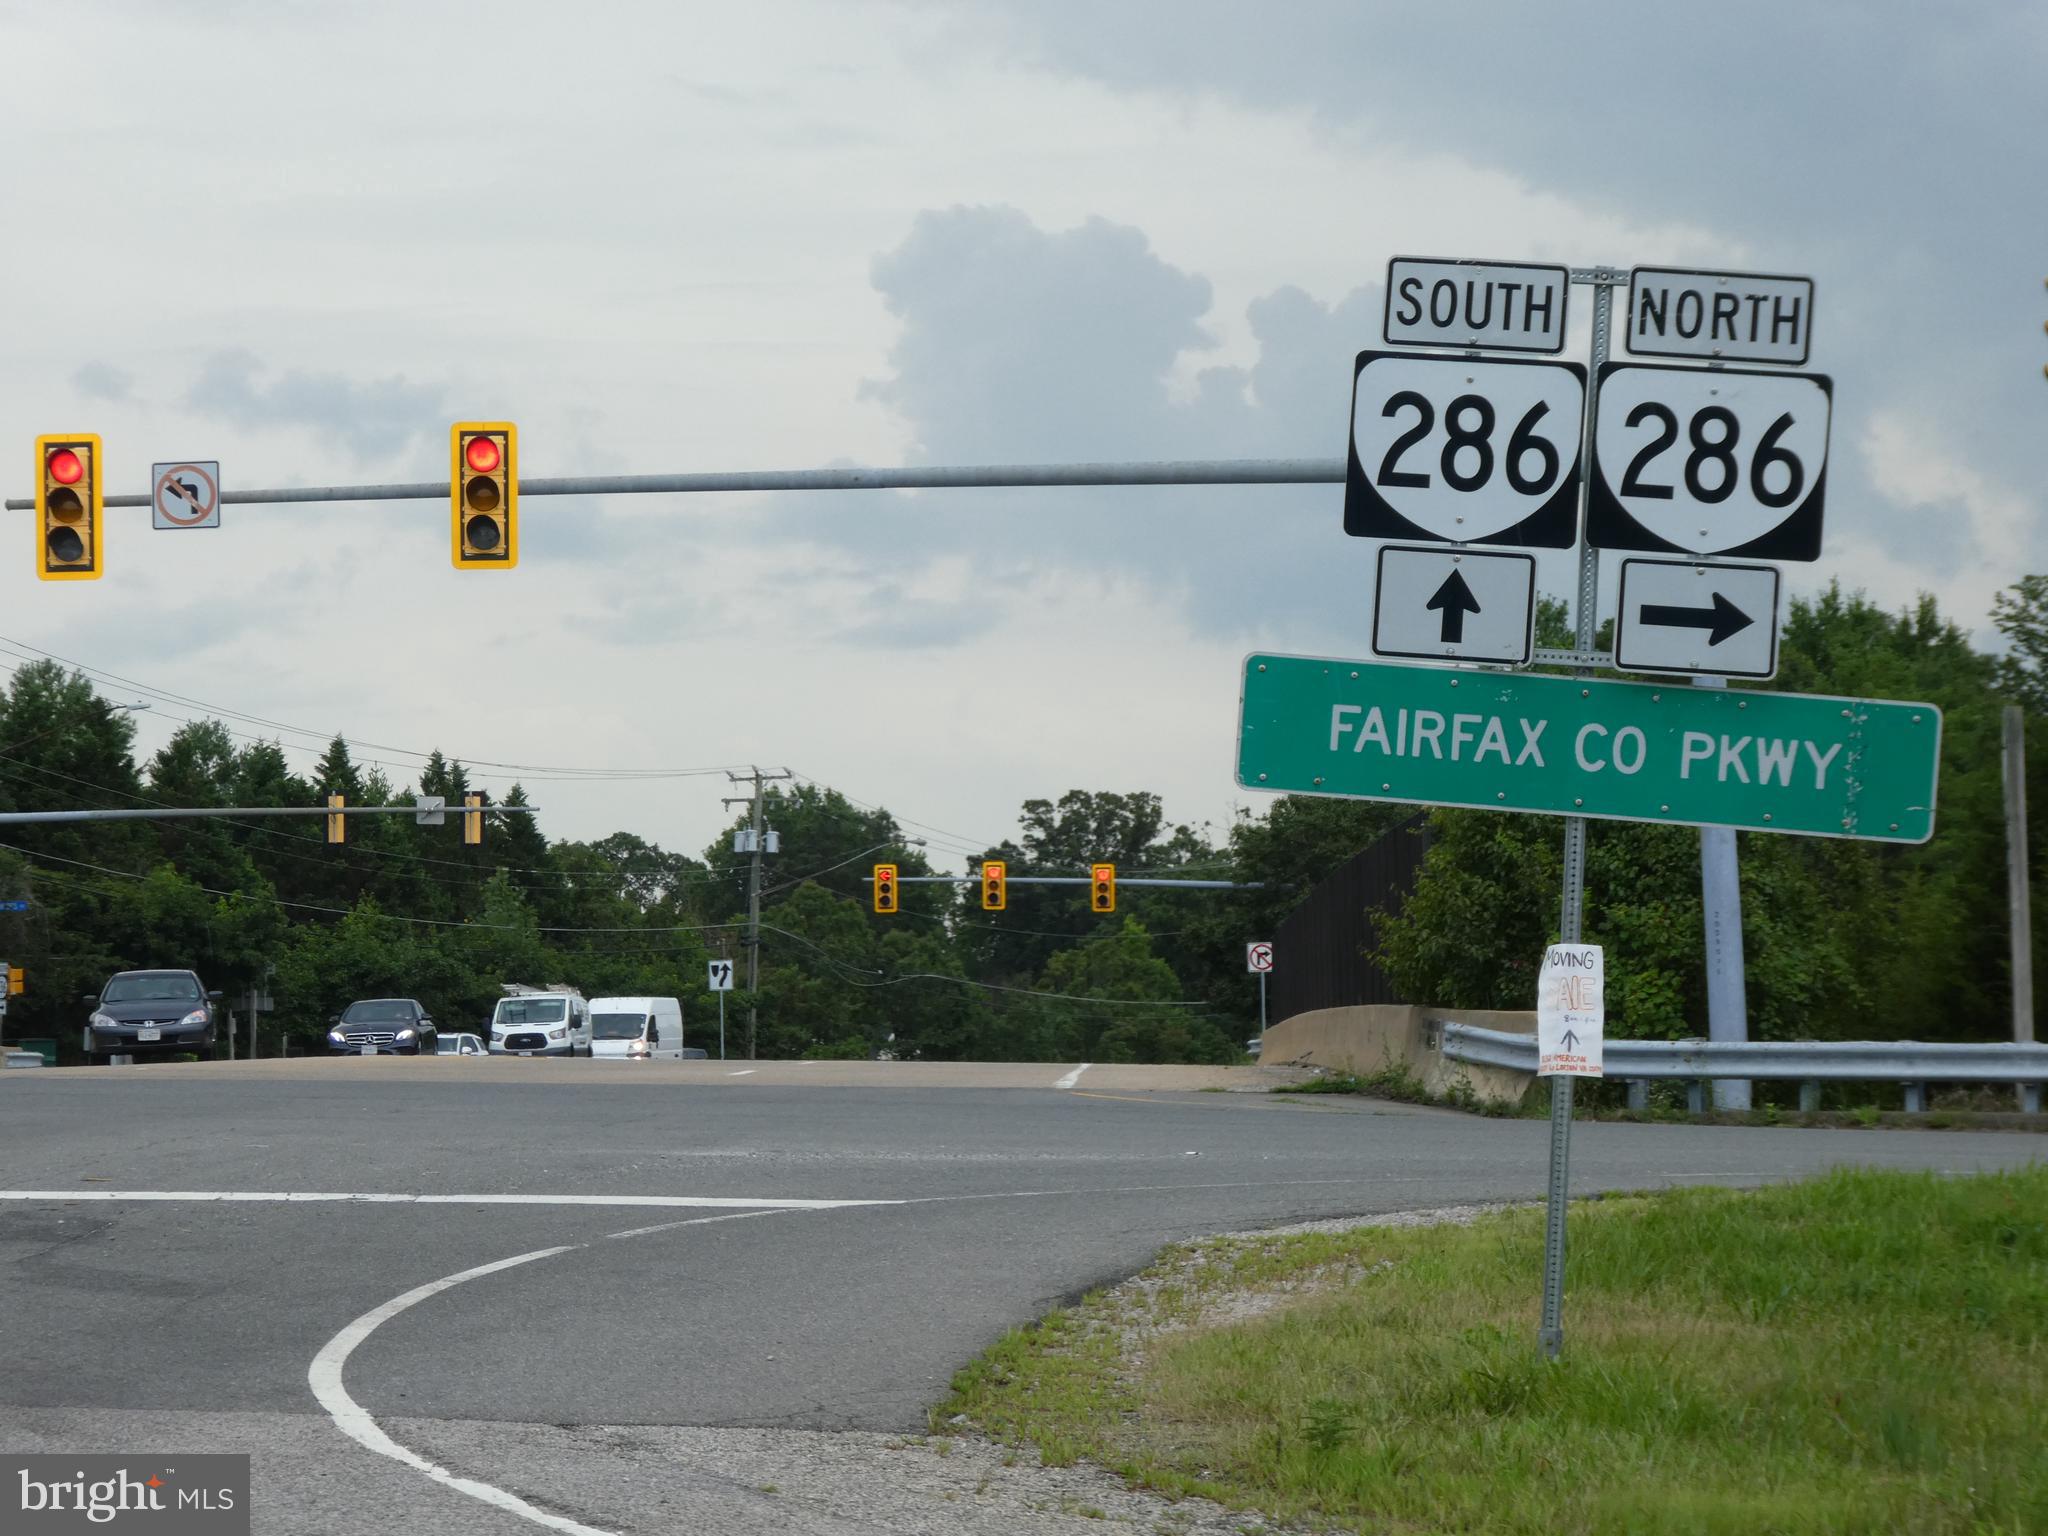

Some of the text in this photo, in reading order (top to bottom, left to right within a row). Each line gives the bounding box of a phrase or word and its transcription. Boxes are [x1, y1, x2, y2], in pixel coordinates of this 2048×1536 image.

[1396, 277, 1554, 334] SOUTH
[1638, 287, 1802, 345] NORTH
[1377, 390, 1560, 497] 286
[1620, 401, 1805, 509] 286
[1329, 704, 1842, 789] FAIRFAX CO PKWY
[1544, 949, 1594, 970] MOVING
